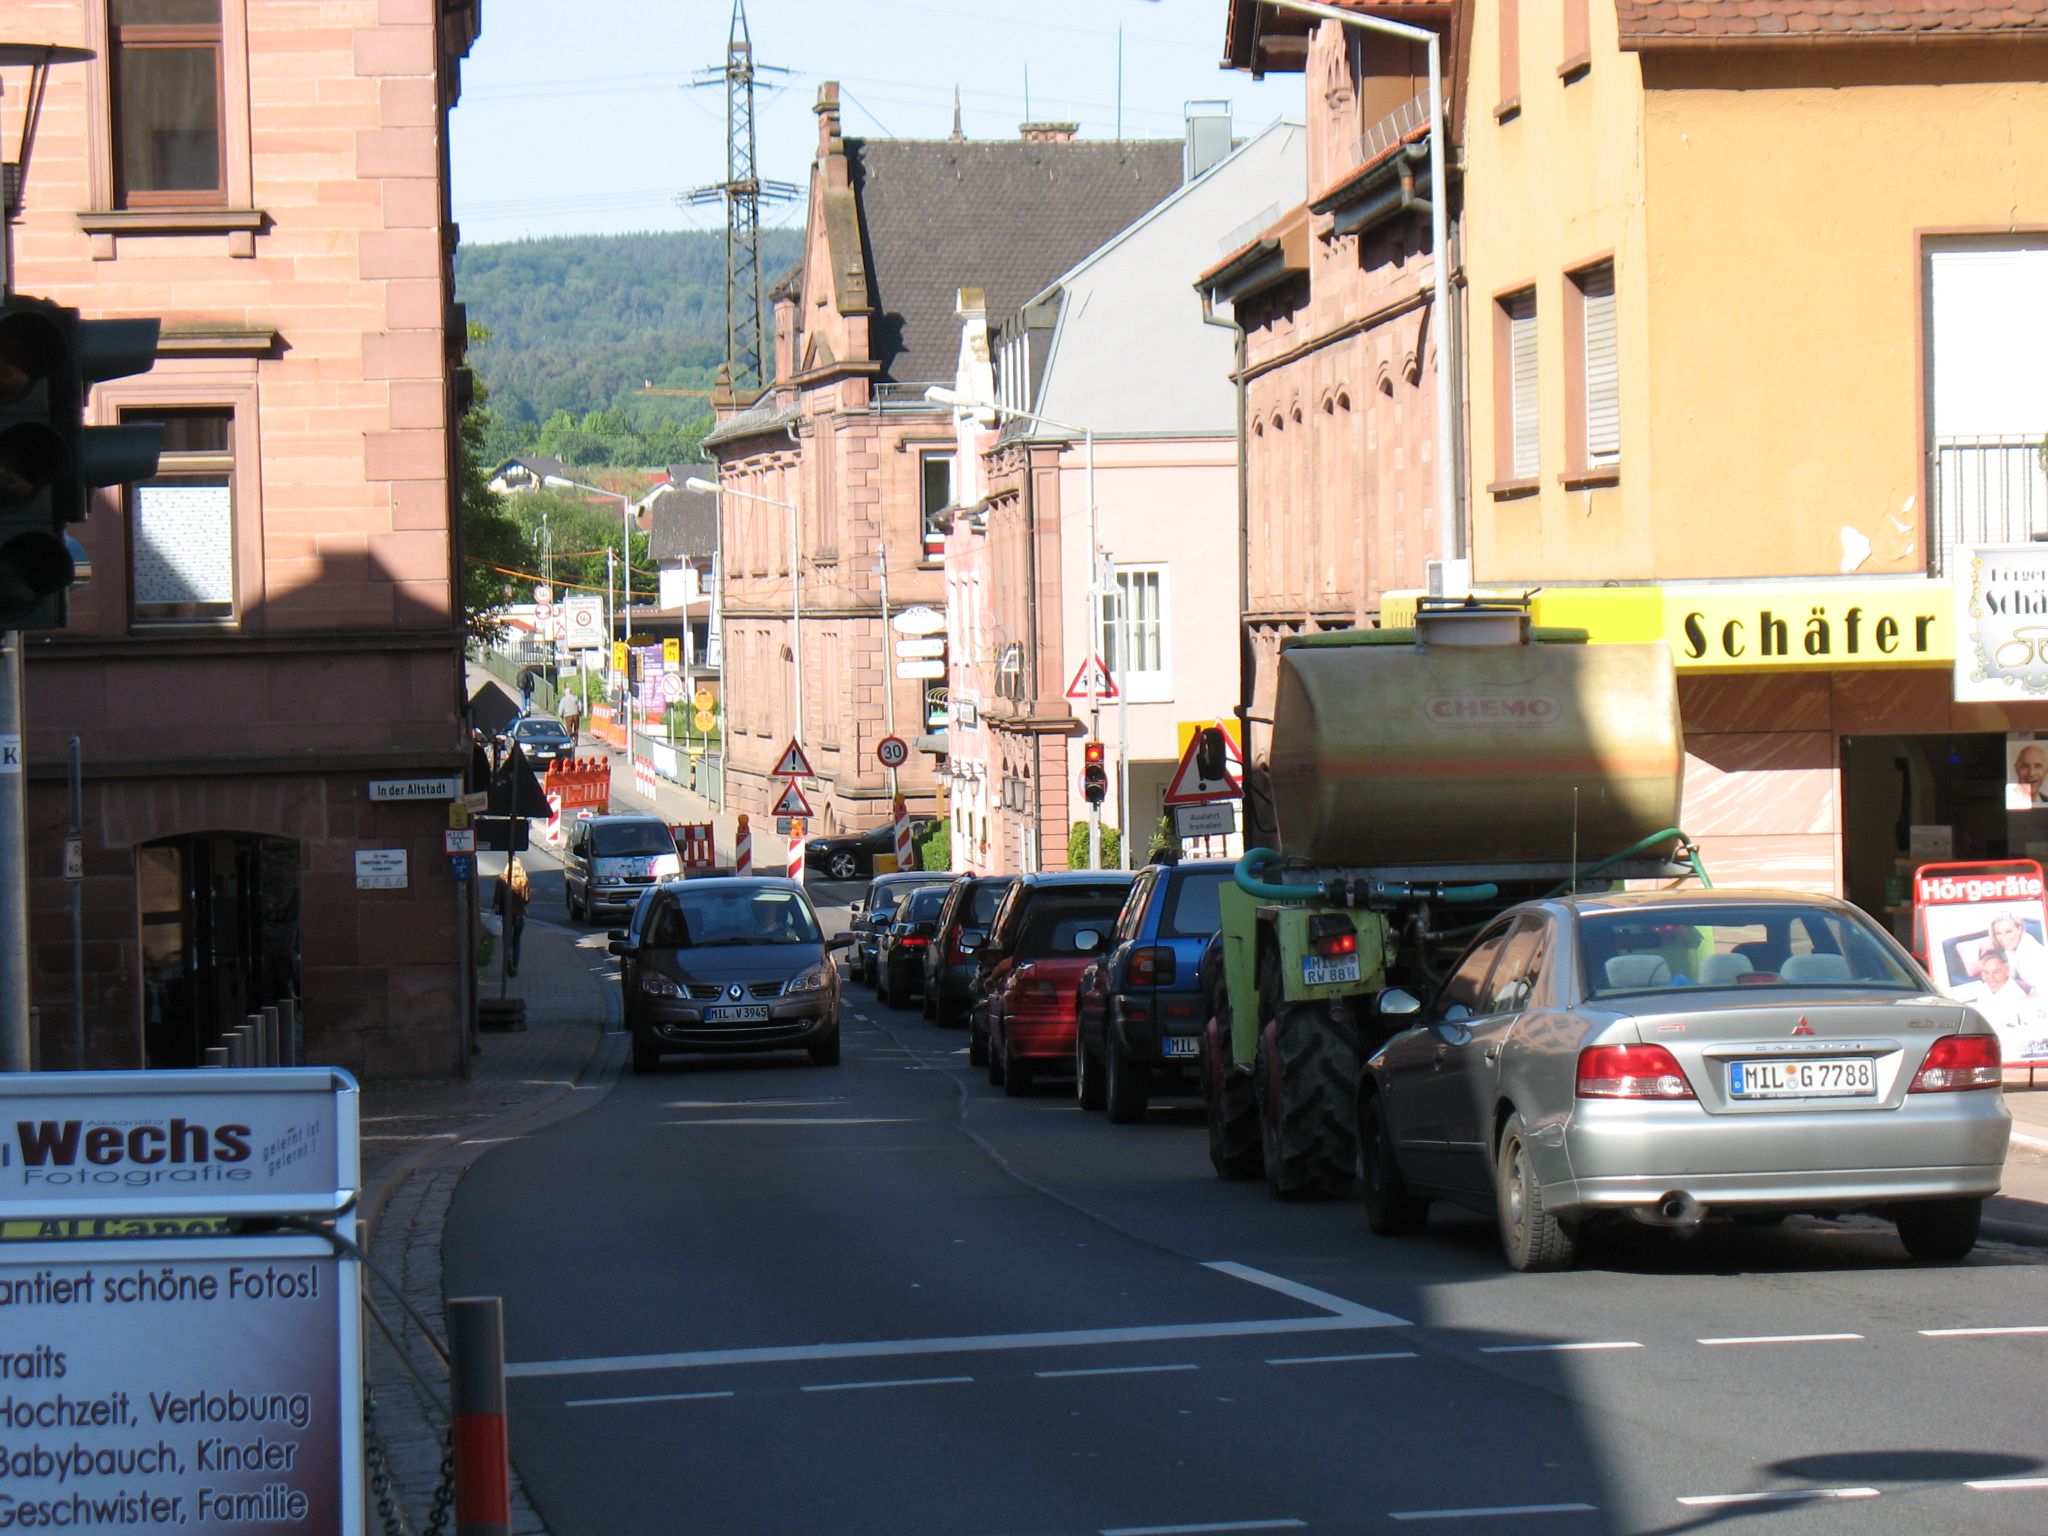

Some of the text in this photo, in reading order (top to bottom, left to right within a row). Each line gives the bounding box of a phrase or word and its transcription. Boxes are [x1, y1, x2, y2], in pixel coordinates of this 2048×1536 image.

[1684, 606, 1937, 659] Schäfer
[1433, 699, 1553, 718] CHEMO
[883, 744, 902, 761] 30
[377, 782, 446, 797] In der Altstadt
[1922, 876, 2042, 901] Hörgeräte
[1308, 971, 1325, 983] RW
[711, 1006, 767, 1020] MIL V 3945
[1171, 1038, 1195, 1052] MIL
[1745, 1063, 1869, 1089] MIL G 7788
[17, 1118, 252, 1166] Wechs
[24, 1164, 252, 1187] Fotografie
[104, 1268, 218, 1303] schöne
[229, 1265, 318, 1300] Fotos!
[0, 1344, 67, 1379] raits
[149, 1388, 311, 1429] Verlobung
[197, 1434, 299, 1471] Kinder
[0, 1483, 307, 1528] Geschwister, Familie
